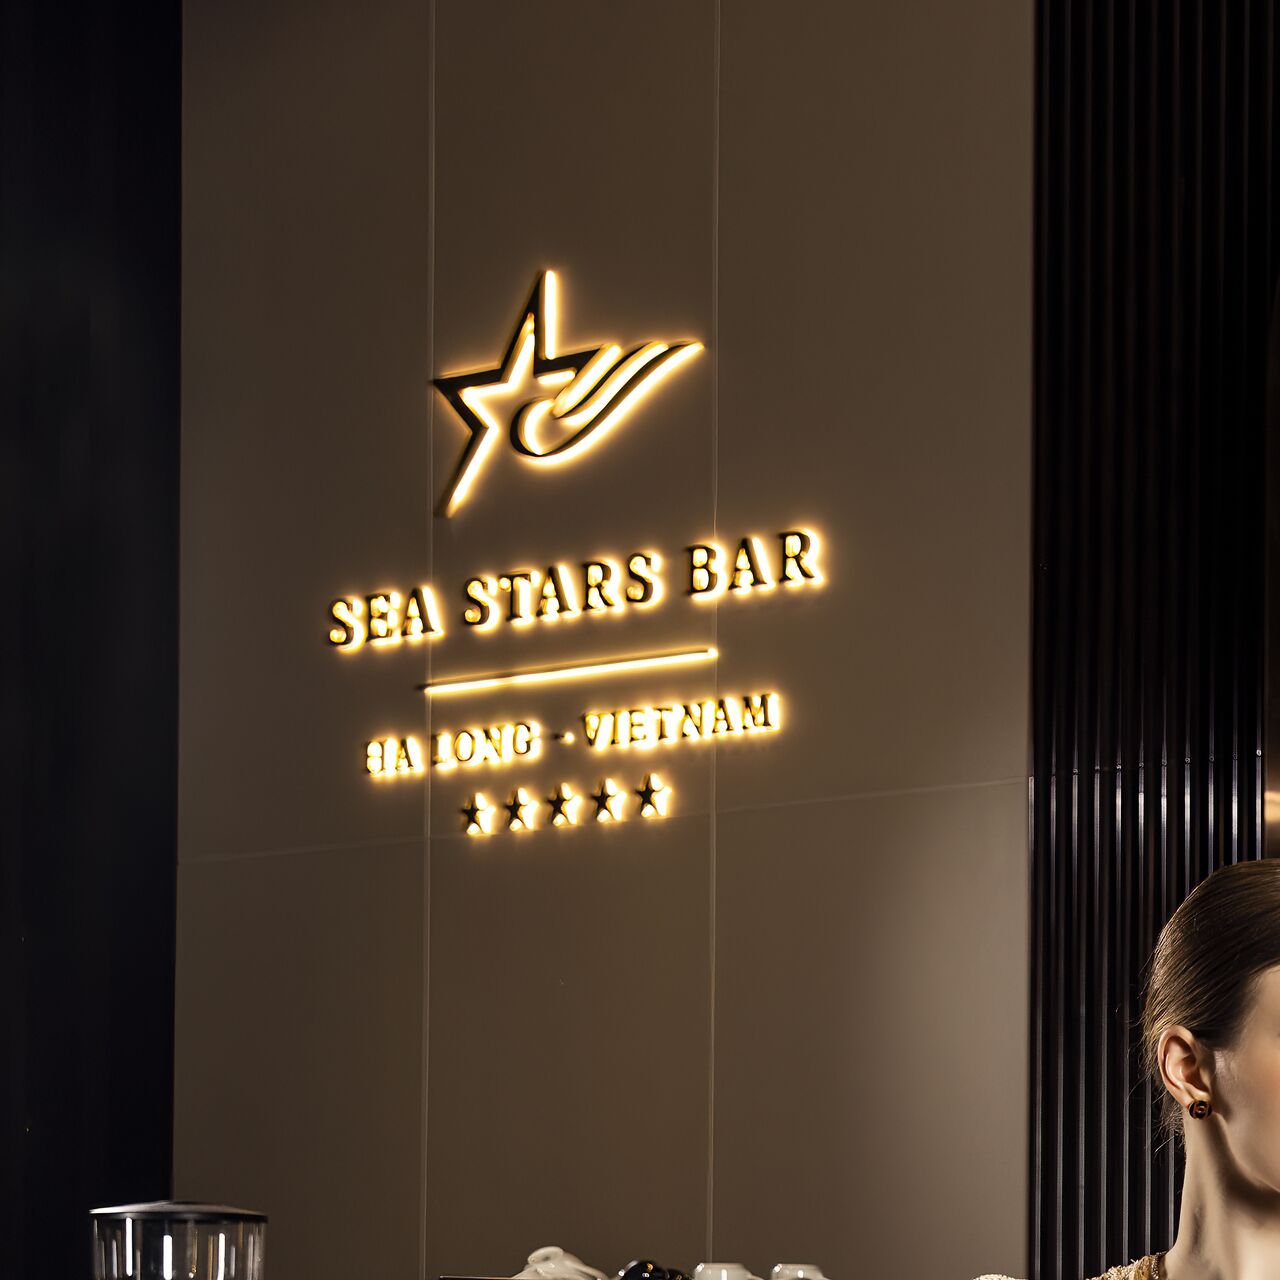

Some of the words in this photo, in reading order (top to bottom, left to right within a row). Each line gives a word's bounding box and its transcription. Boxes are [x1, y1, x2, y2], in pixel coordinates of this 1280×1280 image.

[329, 586, 443, 650] SEA
[463, 552, 660, 627] STARS
[685, 528, 826, 597] BAR
[365, 736, 423, 776] HA
[431, 718, 541, 769] LONG
[584, 692, 781, 749] VIETNAM
